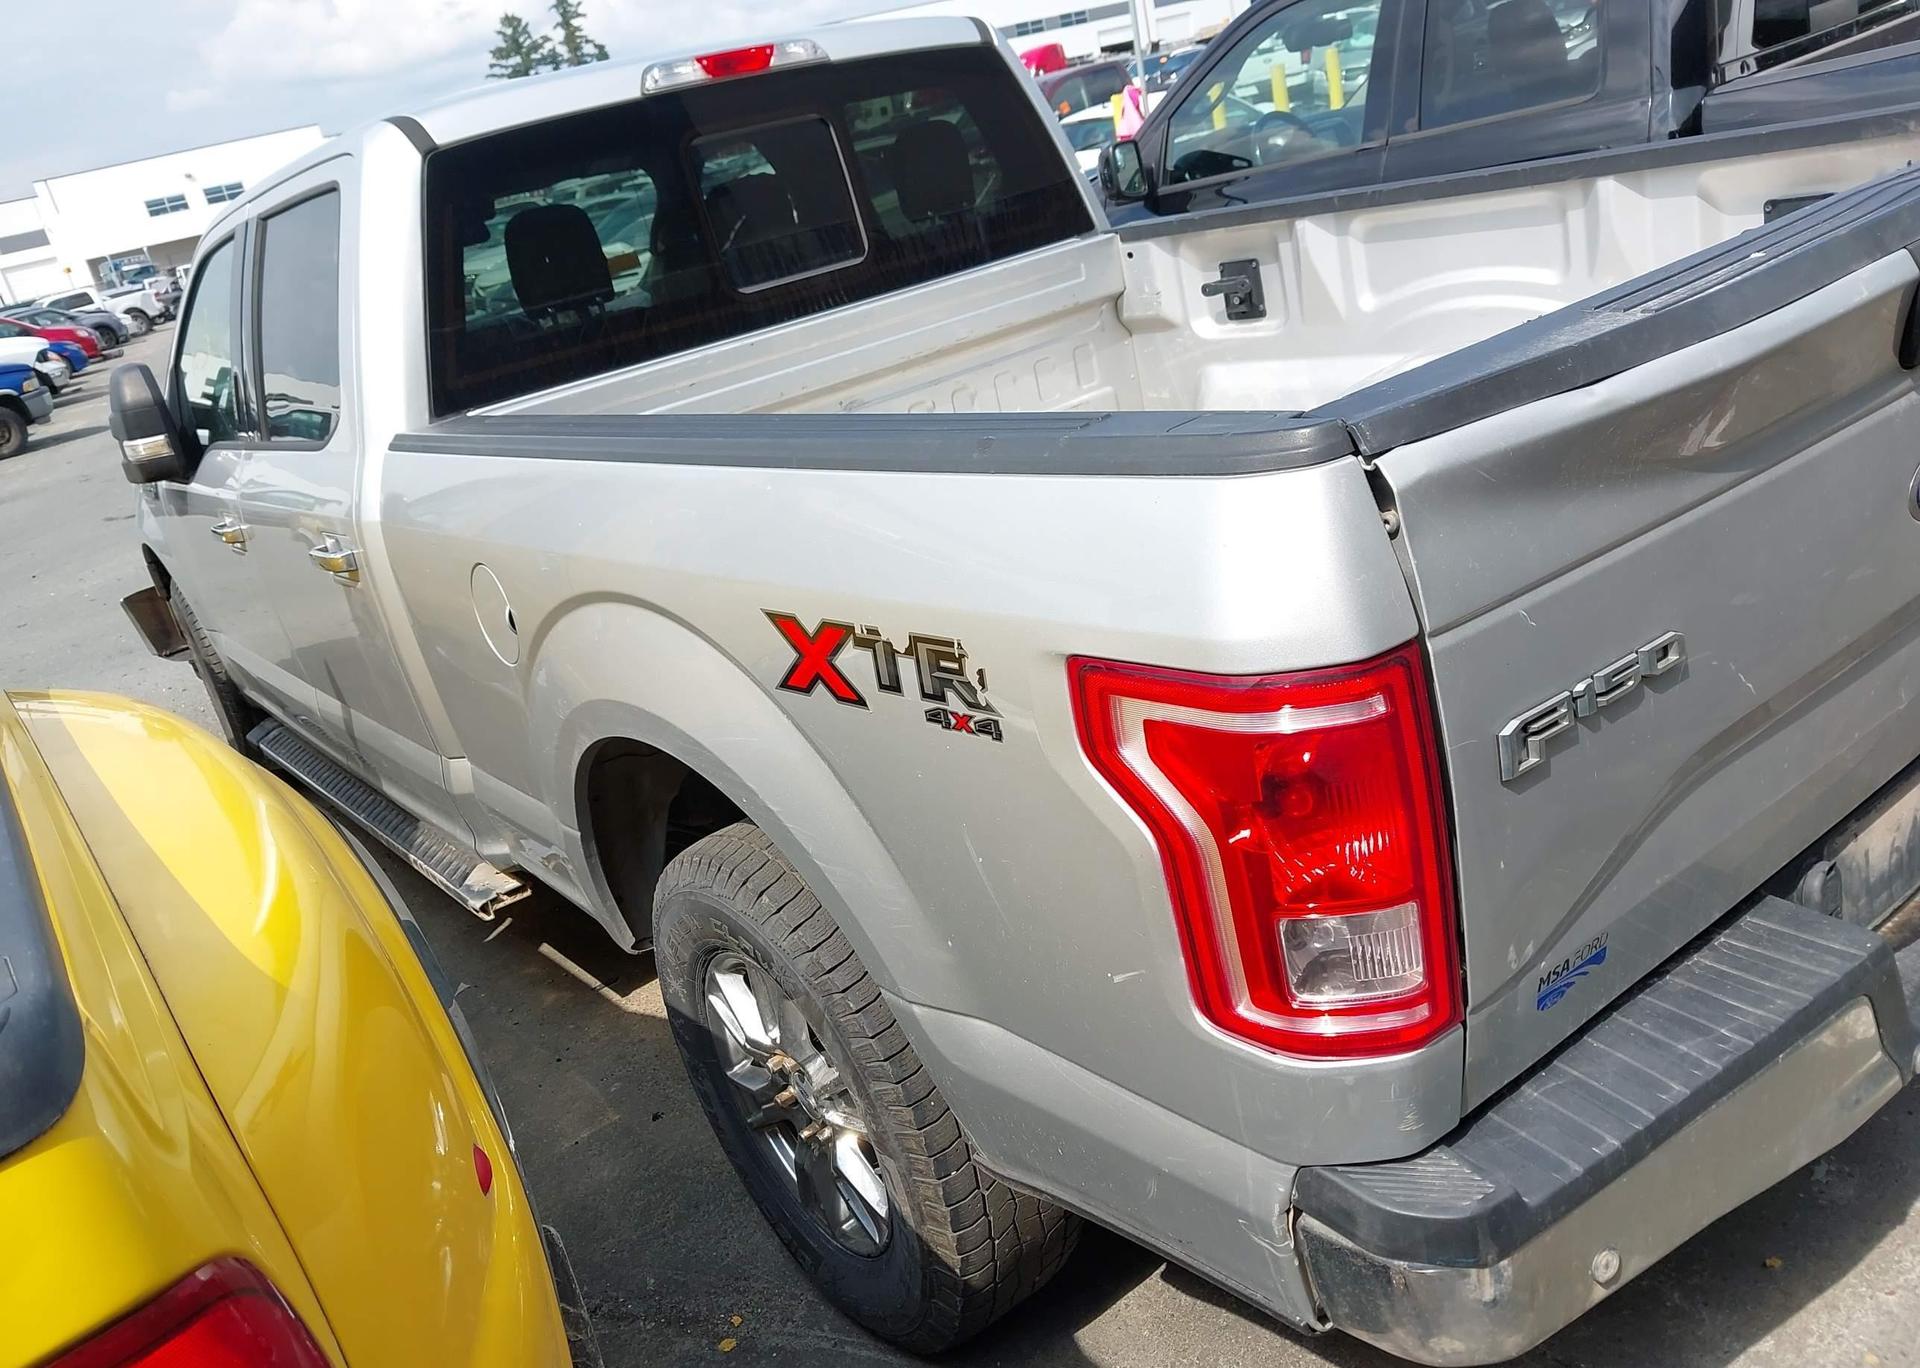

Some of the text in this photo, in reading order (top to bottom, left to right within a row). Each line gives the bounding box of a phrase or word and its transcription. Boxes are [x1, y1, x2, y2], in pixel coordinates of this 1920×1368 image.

[760, 608, 1005, 718] XTR
[1497, 630, 1687, 781] F150
[924, 707, 1004, 742] 4X4
[1537, 932, 1609, 992] MSA FORD
